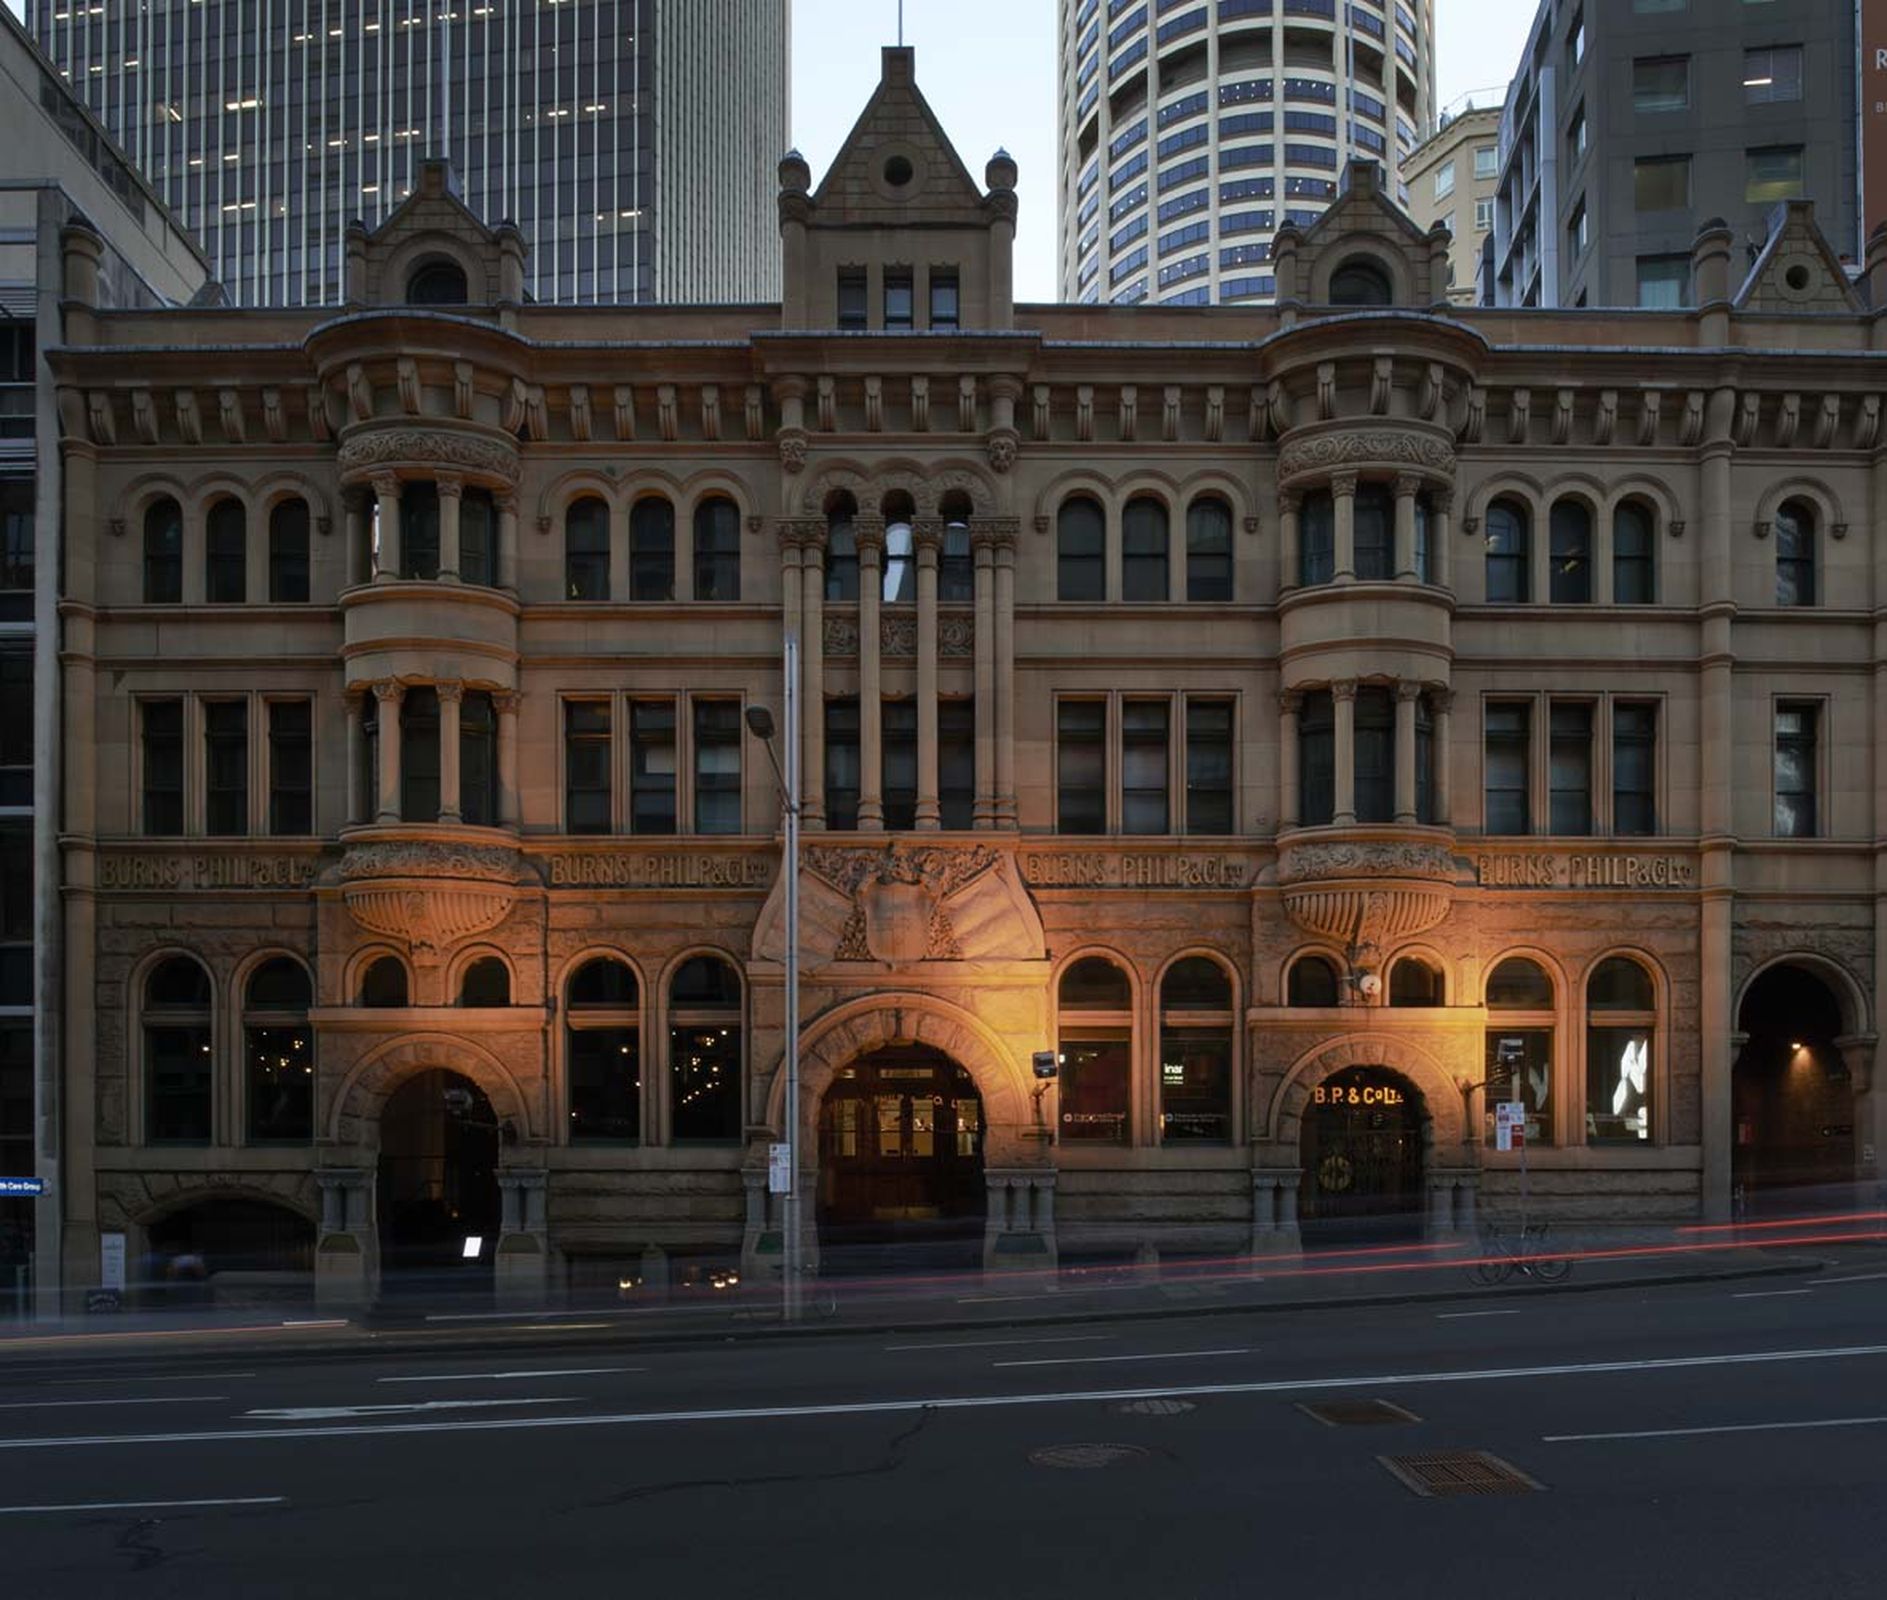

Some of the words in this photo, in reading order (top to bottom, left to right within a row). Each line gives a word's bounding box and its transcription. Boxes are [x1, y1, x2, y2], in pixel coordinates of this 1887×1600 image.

[103, 856, 179, 884] BURNS
[552, 856, 628, 884] BURNS
[1028, 856, 1107, 884] BURNS
[1478, 856, 1554, 884] BURNS
